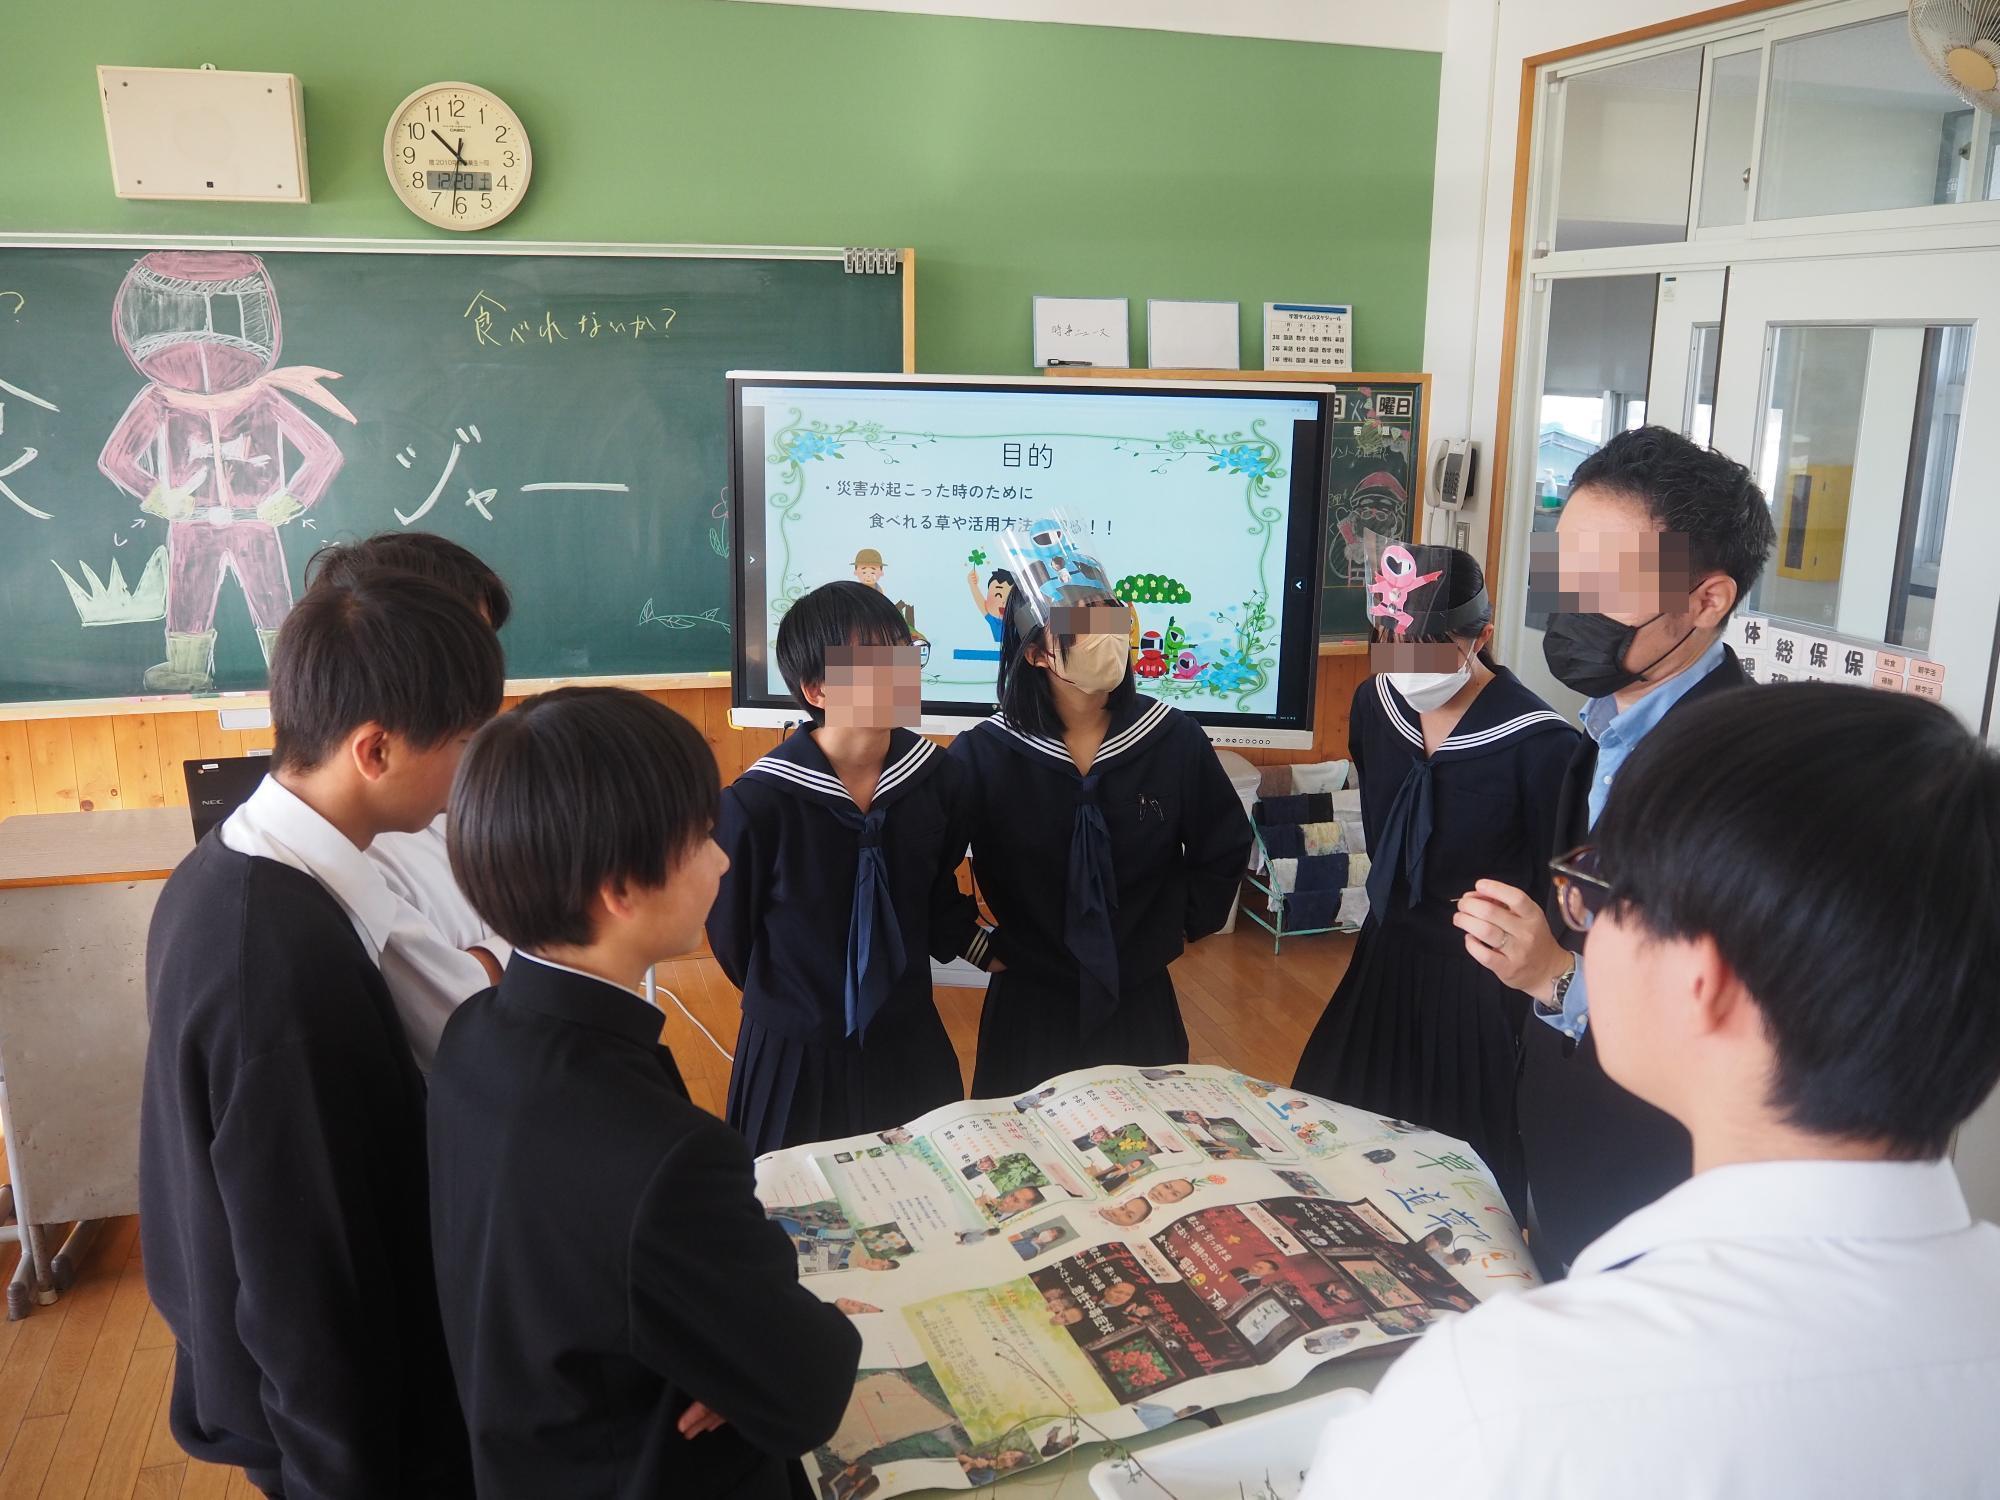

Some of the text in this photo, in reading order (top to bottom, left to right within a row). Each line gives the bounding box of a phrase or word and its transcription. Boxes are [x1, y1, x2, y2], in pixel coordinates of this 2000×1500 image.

[426, 105, 440, 123] 11
[448, 99, 465, 117] 12
[479, 107, 484, 125] 1
[408, 122, 425, 140] 10
[495, 126, 508, 144] 2
[403, 146, 415, 164] 9
[503, 151, 515, 168] 3
[412, 171, 424, 189] 8
[479, 174, 491, 190] 土
[496, 175, 509, 191] 4
[431, 192, 441, 208] 7
[455, 197, 467, 214] 6
[481, 193, 492, 209] 5
[1379, 396, 1411, 415] 曜日
[1003, 442, 1054, 469] 目的
[1745, 621, 1761, 645] 体
[1775, 637, 1794, 664] 総
[1810, 642, 1828, 668] 保
[1844, 650, 1864, 677] 保
